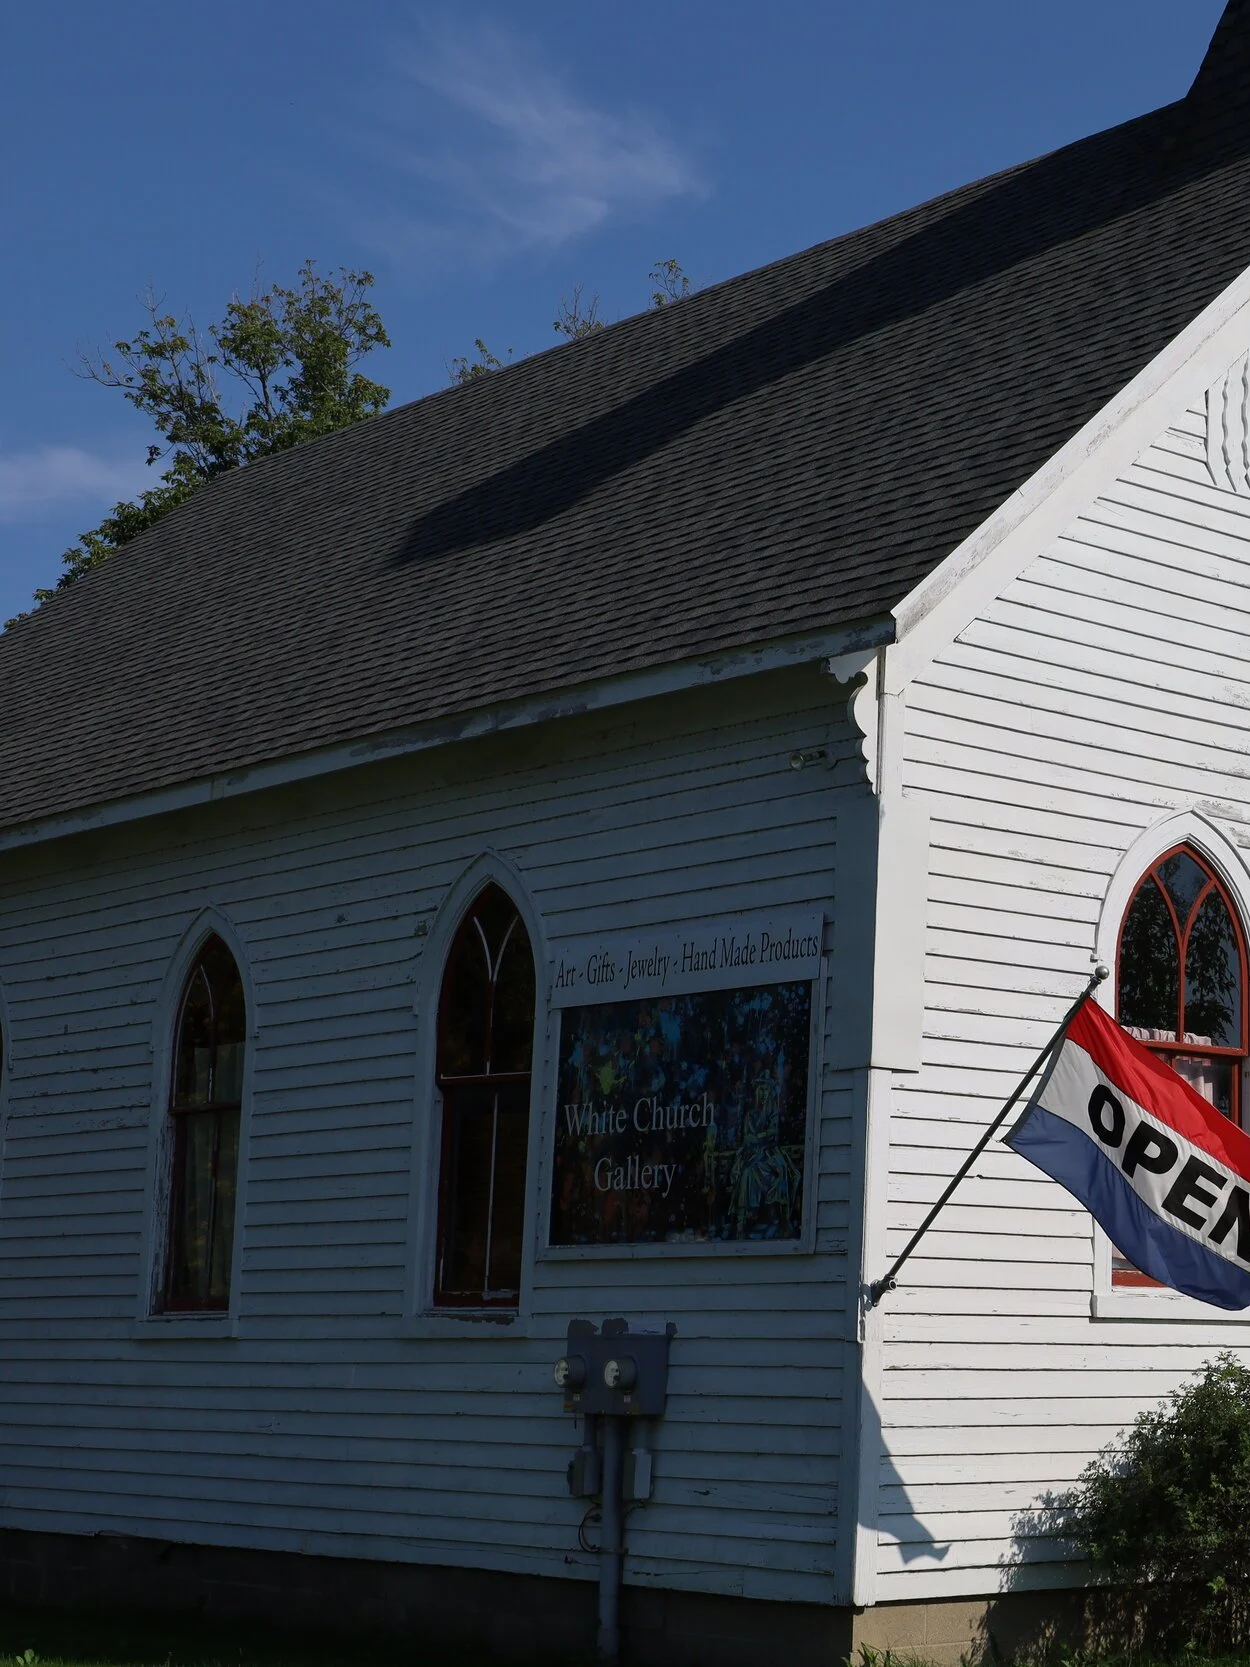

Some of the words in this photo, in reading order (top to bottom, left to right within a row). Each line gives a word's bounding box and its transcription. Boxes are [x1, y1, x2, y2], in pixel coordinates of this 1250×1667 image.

[555, 959, 576, 988] Art
[586, 953, 616, 985] Gifts
[624, 947, 670, 989] Jewelry
[681, 937, 718, 973] Hand
[720, 935, 756, 968] Made
[759, 928, 818, 963] Products
[564, 1100, 628, 1137] White
[633, 1093, 715, 1132] Church
[594, 1154, 677, 1198] Gallery
